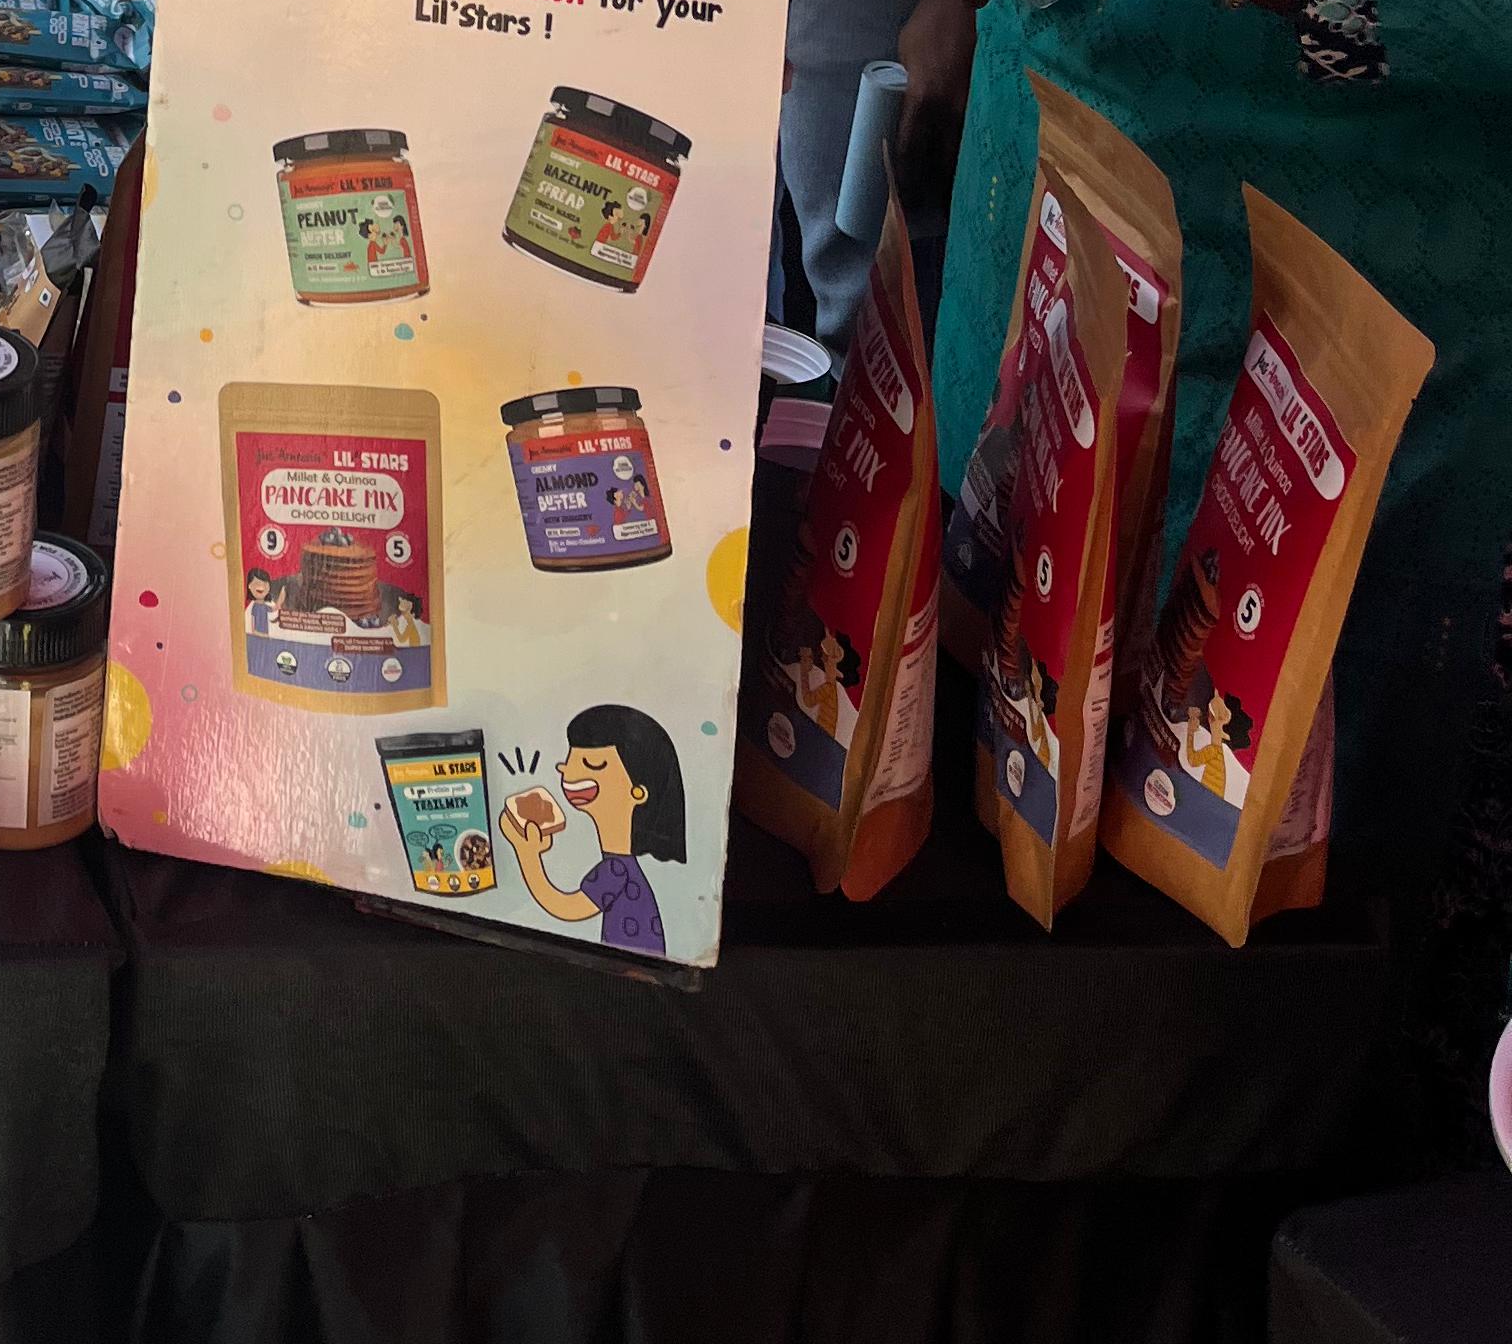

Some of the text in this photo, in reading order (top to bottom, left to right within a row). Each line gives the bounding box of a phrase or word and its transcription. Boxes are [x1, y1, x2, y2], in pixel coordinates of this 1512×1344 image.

[544, 163, 612, 200] HAZELNUT
[537, 180, 586, 211] SPREAD
[297, 208, 359, 229] PEANUT
[846, 430, 887, 493] MIX
[287, 471, 377, 486] Millet & Quinoa
[535, 472, 599, 493] ALMOND
[265, 485, 398, 512] PANCAKE MIX
[538, 492, 588, 512] BUTTER
[290, 509, 377, 524] CHOCO DELIGHT
[1256, 495, 1291, 556] MIX
[266, 530, 277, 551] 9
[393, 540, 405, 559] 5
[839, 534, 853, 561] 5
[1040, 561, 1050, 587] 5
[1241, 597, 1257, 623] 5
[449, 762, 477, 774] STARS
